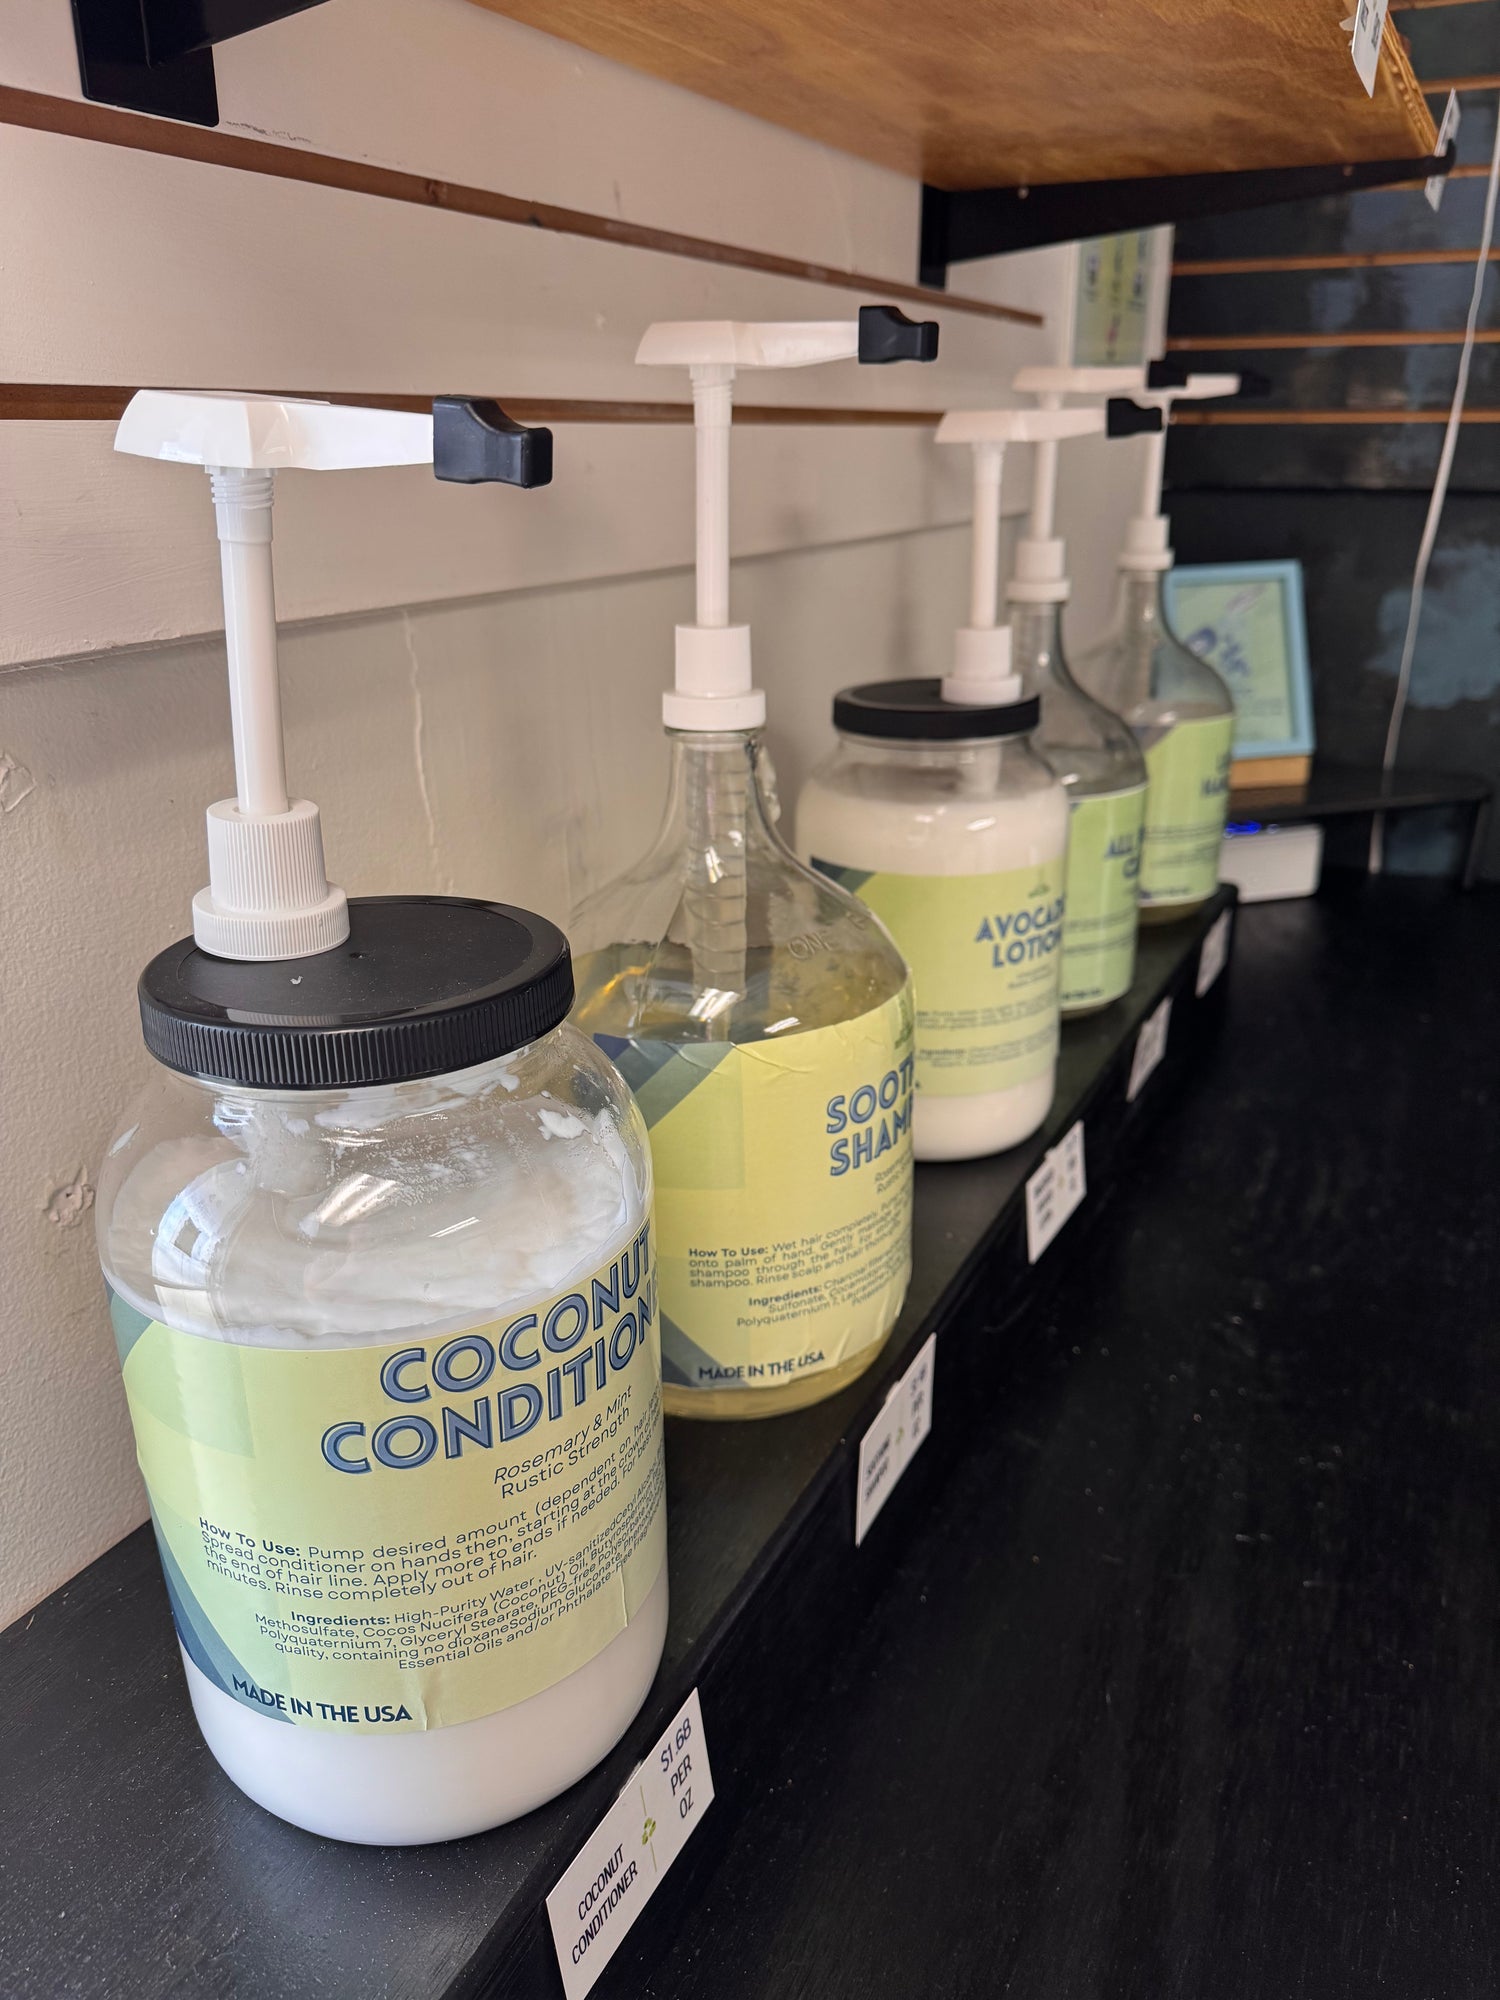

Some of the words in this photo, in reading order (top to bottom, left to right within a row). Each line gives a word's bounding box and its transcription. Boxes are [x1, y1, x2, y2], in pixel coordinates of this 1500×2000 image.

[688, 1247, 718, 1258] How
[721, 1247, 737, 1258] To
[741, 1245, 769, 1257] Use:
[771, 1240, 796, 1253] Wet
[800, 1233, 823, 1248] hair
[688, 1258, 719, 1268] onto
[724, 1256, 758, 1269] palm
[763, 1253, 776, 1265] of
[688, 1267, 750, 1279] shampoo
[756, 1258, 806, 1275] through
[810, 1251, 829, 1264] the
[688, 1277, 754, 1290] shampoo.
[755, 1273, 790, 1286] Rinse
[792, 1263, 823, 1280] scalp
[824, 1256, 845, 1269] and
[379, 1218, 651, 1404] COCONUT
[736, 1302, 832, 1328] Polyquaternium
[748, 1284, 824, 1307] Ingredients:
[321, 1268, 656, 1475] CONDITION
[698, 1365, 746, 1380] MADE
[748, 1363, 765, 1377] IN
[768, 1359, 795, 1376] THE
[797, 1350, 826, 1368] USA
[493, 1426, 589, 1485] Rosemary
[593, 1413, 603, 1431] &
[606, 1384, 633, 1415] Mint
[501, 1460, 565, 1499] Rustic
[568, 1405, 631, 1467] Strength
[199, 1516, 231, 1540] How
[235, 1532, 256, 1548] To
[262, 1539, 301, 1557] Use:
[308, 1546, 365, 1562] Pump
[372, 1535, 447, 1559] desired
[456, 1510, 527, 1545] amount
[535, 1452, 617, 1516] (dependent
[618, 1437, 632, 1455] on
[633, 1409, 648, 1437] hair
[201, 1530, 254, 1561] Spread
[258, 1554, 366, 1574] conditioner
[371, 1561, 396, 1573] on
[401, 1549, 462, 1570] hands
[465, 1533, 513, 1556] then,
[517, 1496, 579, 1537] starting
[583, 1484, 597, 1501] at
[597, 1465, 618, 1493] the
[618, 1433, 645, 1470] crown
[203, 1544, 228, 1565] the
[231, 1558, 261, 1575] end
[265, 1567, 284, 1580] of
[288, 1571, 324, 1587] hair
[328, 1573, 368, 1588] line.
[373, 1568, 429, 1588] Apply
[435, 1556, 485, 1578] more
[488, 1548, 508, 1562] to
[512, 1525, 553, 1553] ends
[556, 1514, 569, 1532] if
[571, 1475, 621, 1523] needed.
[621, 1458, 638, 1480] For
[206, 1558, 272, 1592] minutes.
[275, 1581, 324, 1600] Rinse
[327, 1580, 438, 1603] completely
[441, 1571, 475, 1590] out
[478, 1561, 498, 1579] of
[500, 1549, 538, 1572] hair.
[254, 1612, 360, 1639] Methosulfate,
[363, 1624, 417, 1639] Cocos
[420, 1607, 489, 1633] Nucifera
[493, 1570, 566, 1614] (Coconut)
[568, 1559, 589, 1576] Oil,
[260, 1625, 382, 1649] Polyquaternium
[383, 1637, 398, 1649] 7,
[400, 1622, 467, 1648] Glyceryl
[470, 1602, 539, 1632] Stearate,
[541, 1562, 597, 1604] PEG-free
[274, 1641, 330, 1661] quality,
[332, 1647, 420, 1661] containing
[423, 1643, 445, 1656] no
[565, 1551, 623, 1601] Gluconate,
[290, 1610, 391, 1627] Ingredients:
[394, 1596, 488, 1624] High-Purity
[399, 1646, 471, 1670] Essential
[474, 1636, 503, 1655] Oils
[506, 1613, 555, 1644] and/or
[231, 1673, 288, 1711] MADE
[290, 1696, 314, 1718] IN
[315, 1701, 361, 1724] THE
[363, 1703, 414, 1724] USA
[669, 1753, 693, 1797] PER
[679, 1786, 695, 1819] OZ
[578, 1842, 625, 1921] COCONUT
[571, 1859, 639, 1966] CONDITIONER
